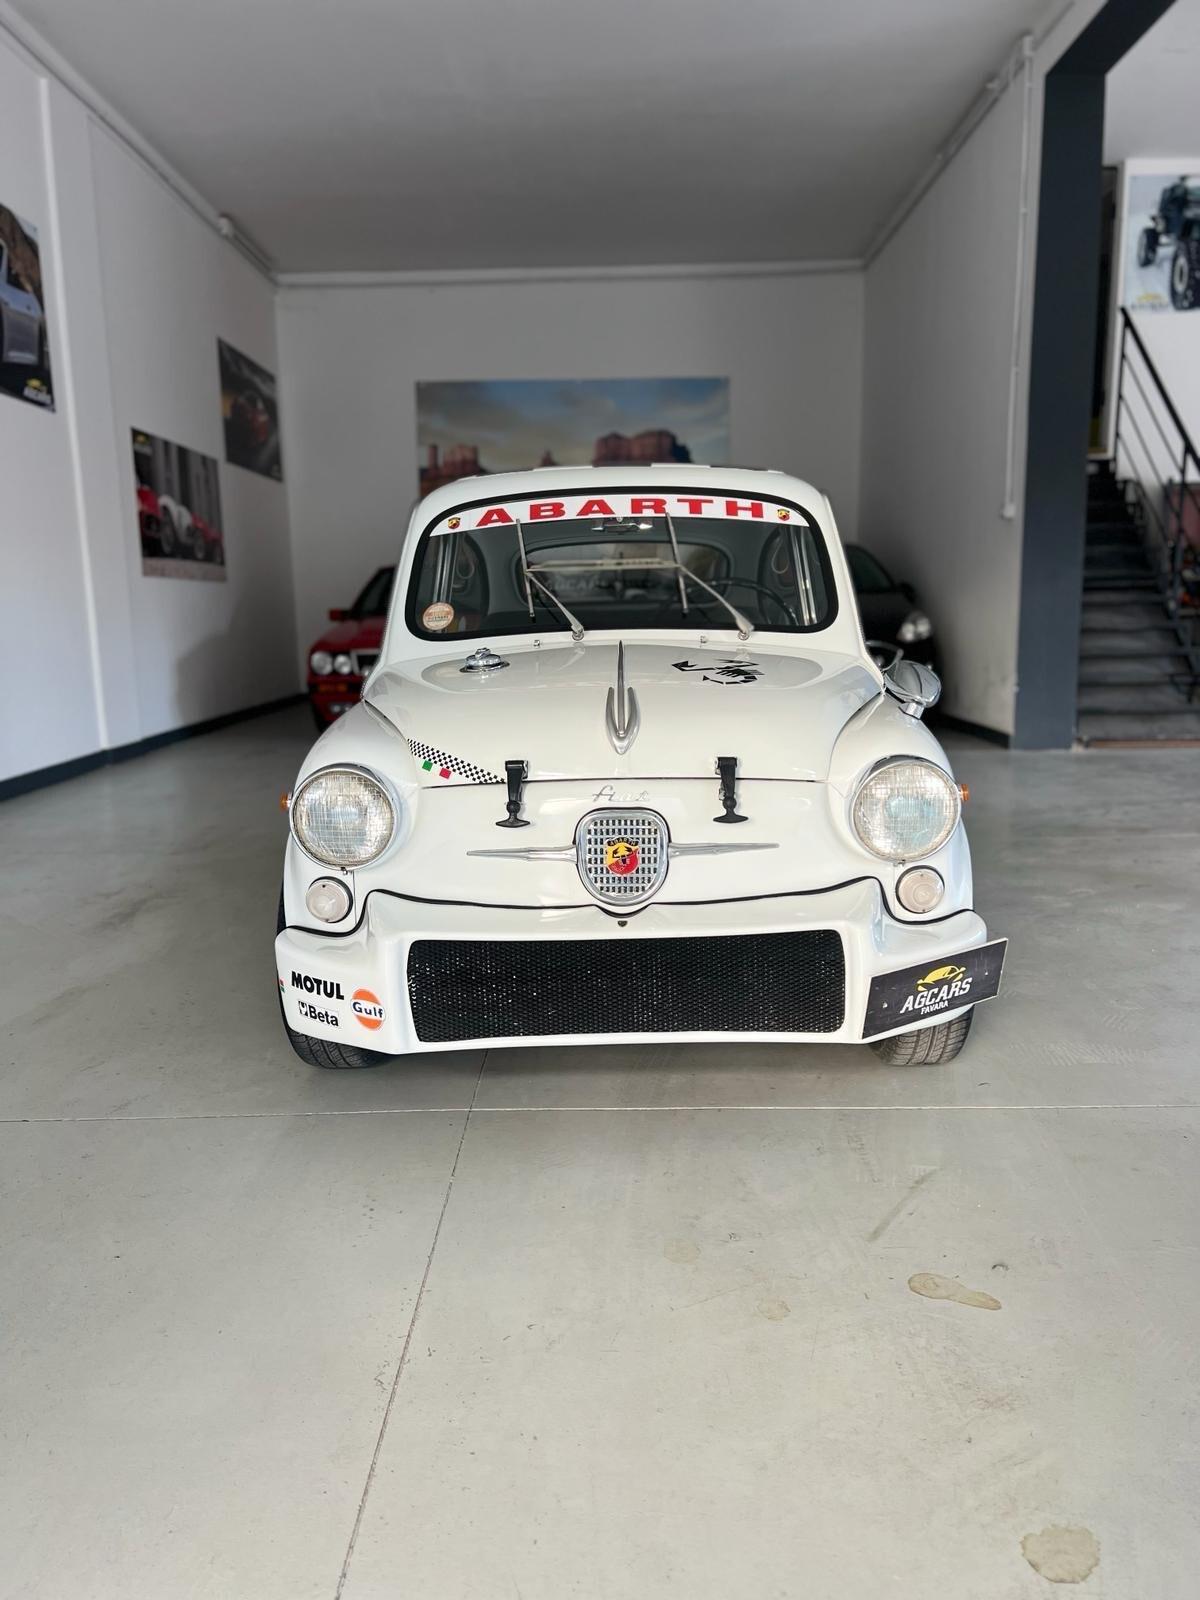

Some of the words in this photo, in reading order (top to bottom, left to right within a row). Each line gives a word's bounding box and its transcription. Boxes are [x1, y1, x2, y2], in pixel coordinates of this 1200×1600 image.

[475, 499, 764, 527] ABARTH
[291, 970, 344, 1000] MOTUL
[900, 977, 973, 1014] AGCARS
[309, 1004, 339, 1027] Beta
[352, 1001, 383, 1018] Gulf
[920, 1000, 949, 1015] FAVARA
